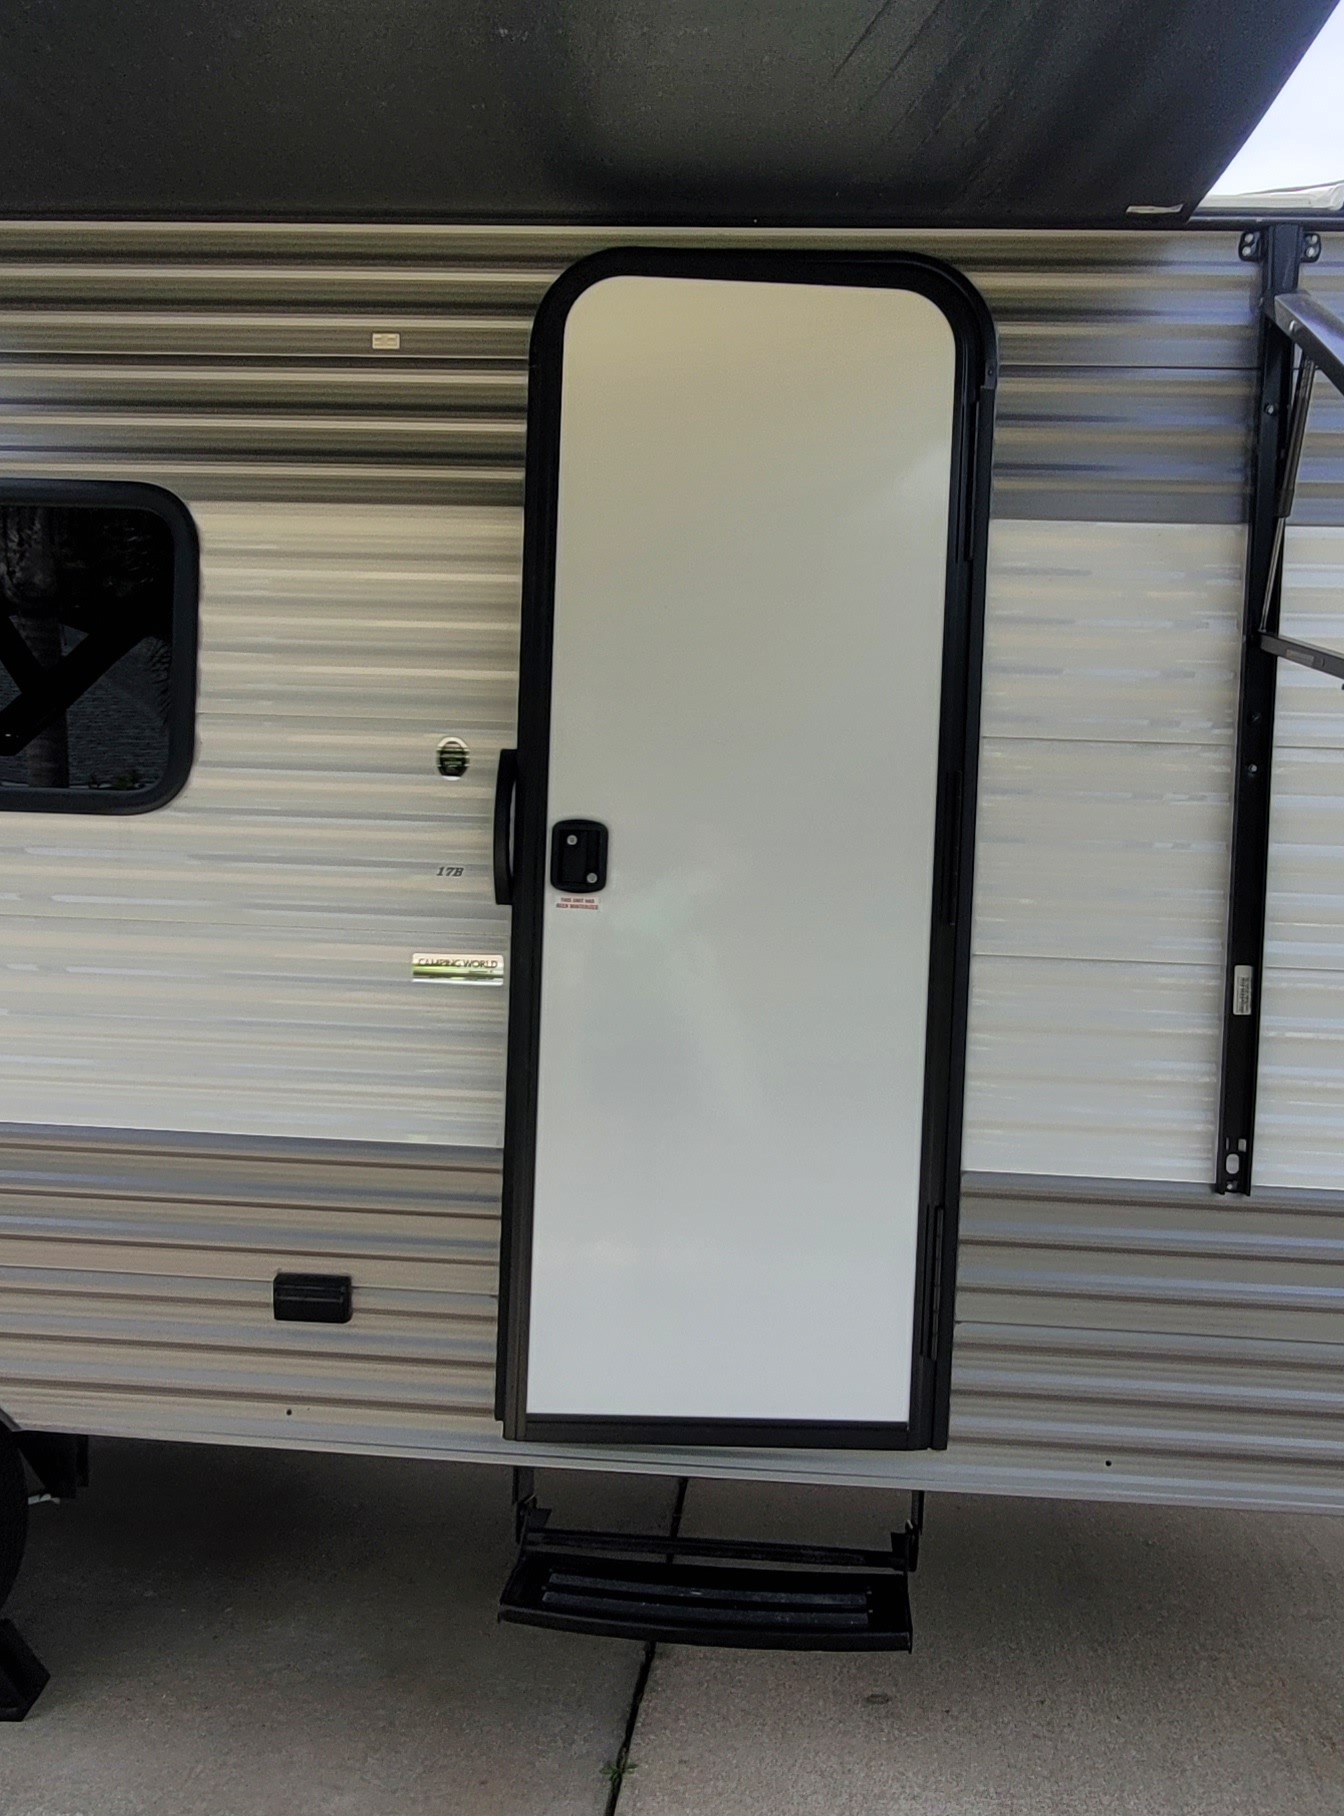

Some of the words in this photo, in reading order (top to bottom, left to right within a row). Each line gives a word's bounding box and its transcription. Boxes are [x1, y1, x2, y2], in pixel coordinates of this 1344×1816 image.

[436, 866, 465, 877] 17B
[418, 958, 462, 967] CAMPING
[462, 959, 498, 969] WORLD
